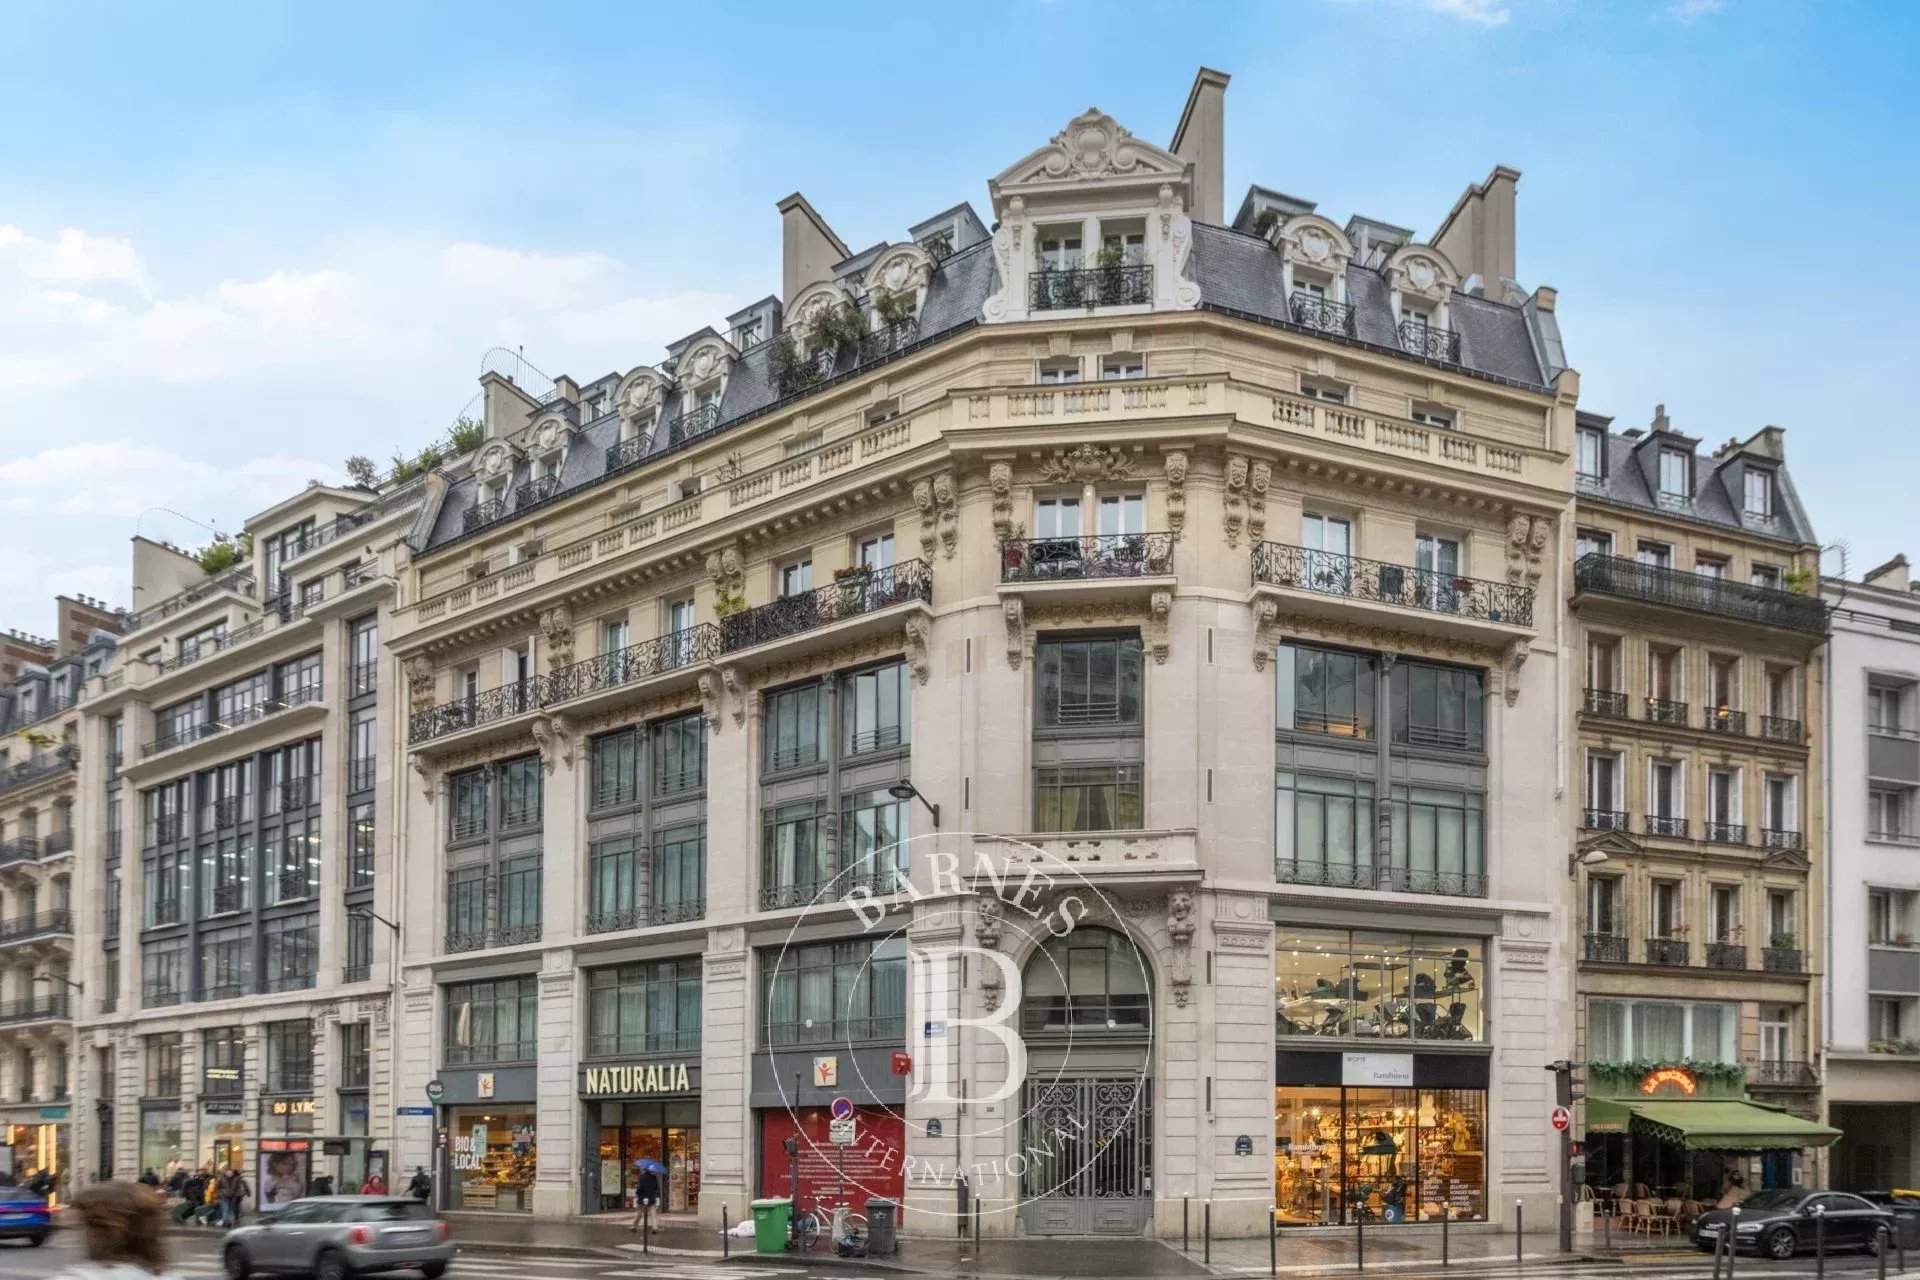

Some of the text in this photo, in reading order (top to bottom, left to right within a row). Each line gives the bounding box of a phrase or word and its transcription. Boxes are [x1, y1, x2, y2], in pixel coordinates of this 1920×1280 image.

[586, 1063, 689, 1094] NATURALIA
[455, 1136, 469, 1151] BIO
[455, 1154, 481, 1169] LOCAL
